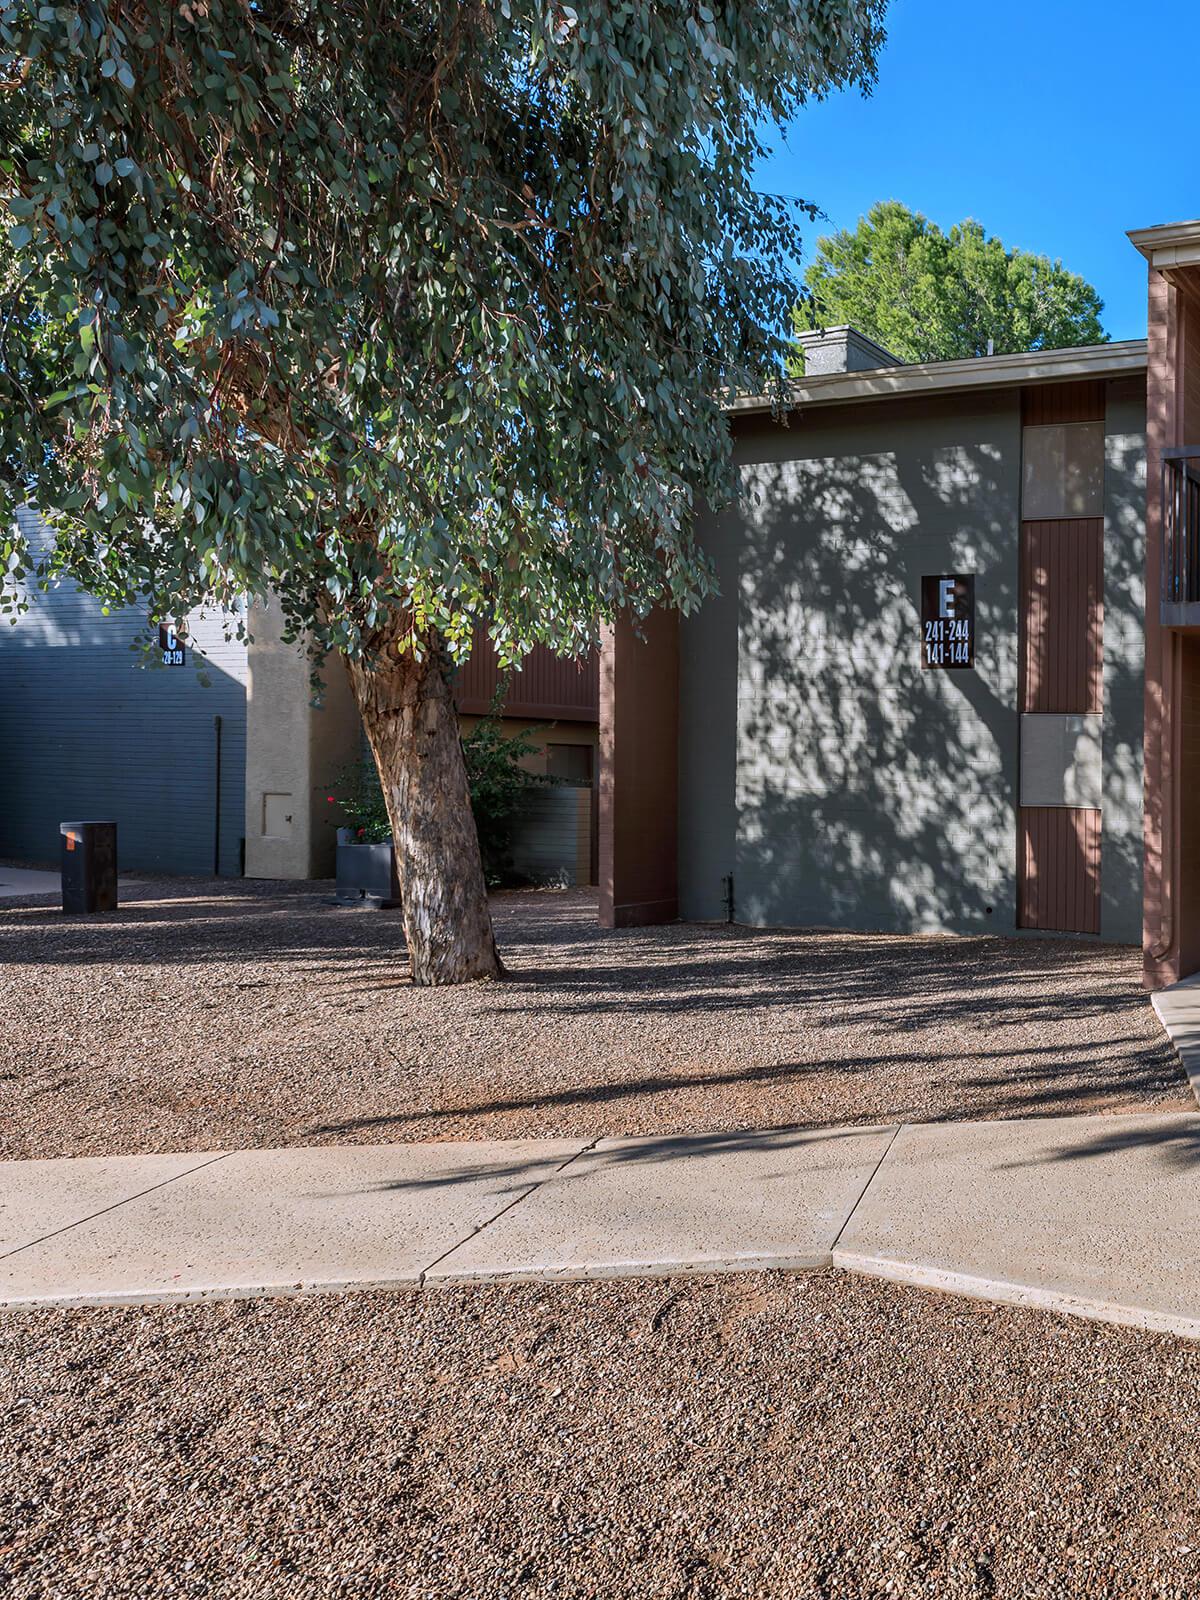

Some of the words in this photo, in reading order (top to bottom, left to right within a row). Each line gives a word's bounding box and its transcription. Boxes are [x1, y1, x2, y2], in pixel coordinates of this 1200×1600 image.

[939, 580, 955, 617] E
[167, 624, 177, 650] C
[925, 620, 969, 641] 241-244
[926, 643, 969, 664] 141-144
